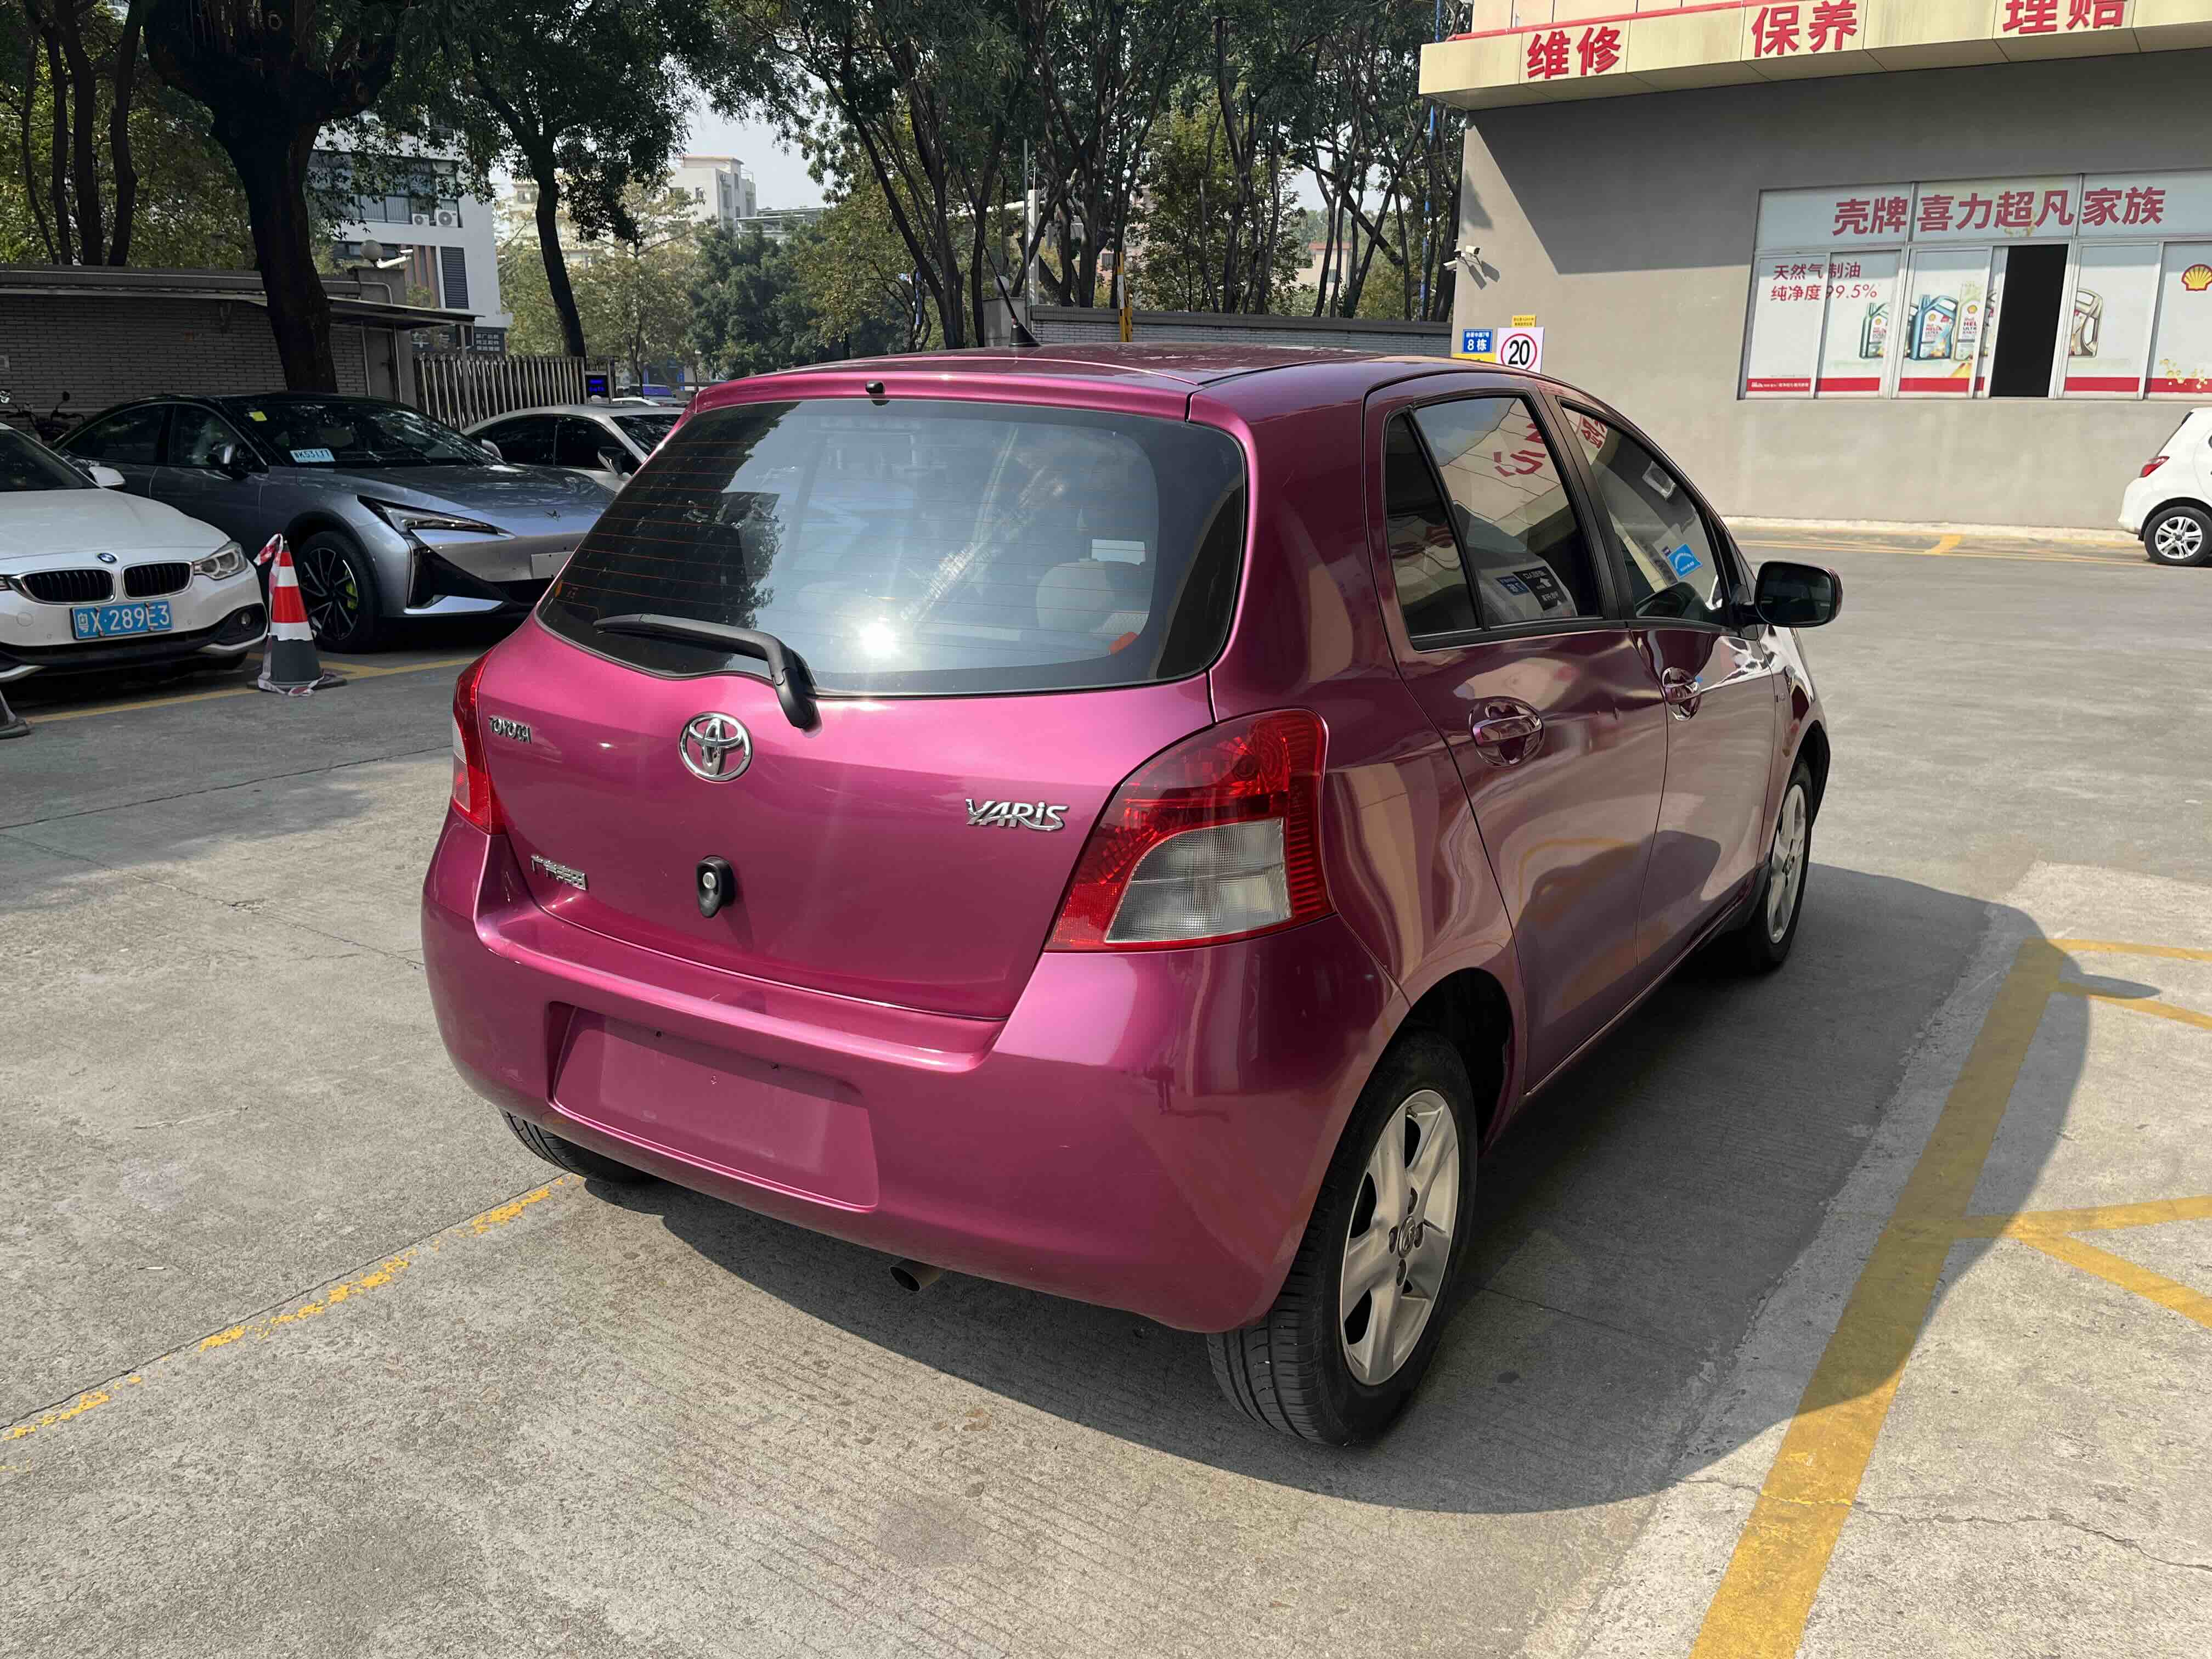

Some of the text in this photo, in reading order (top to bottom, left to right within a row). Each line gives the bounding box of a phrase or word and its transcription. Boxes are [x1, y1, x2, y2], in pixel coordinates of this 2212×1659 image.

[1527, 26, 1621, 78] 维修
[1751, 1, 1857, 57] 保养
[1508, 340, 1530, 365] 20
